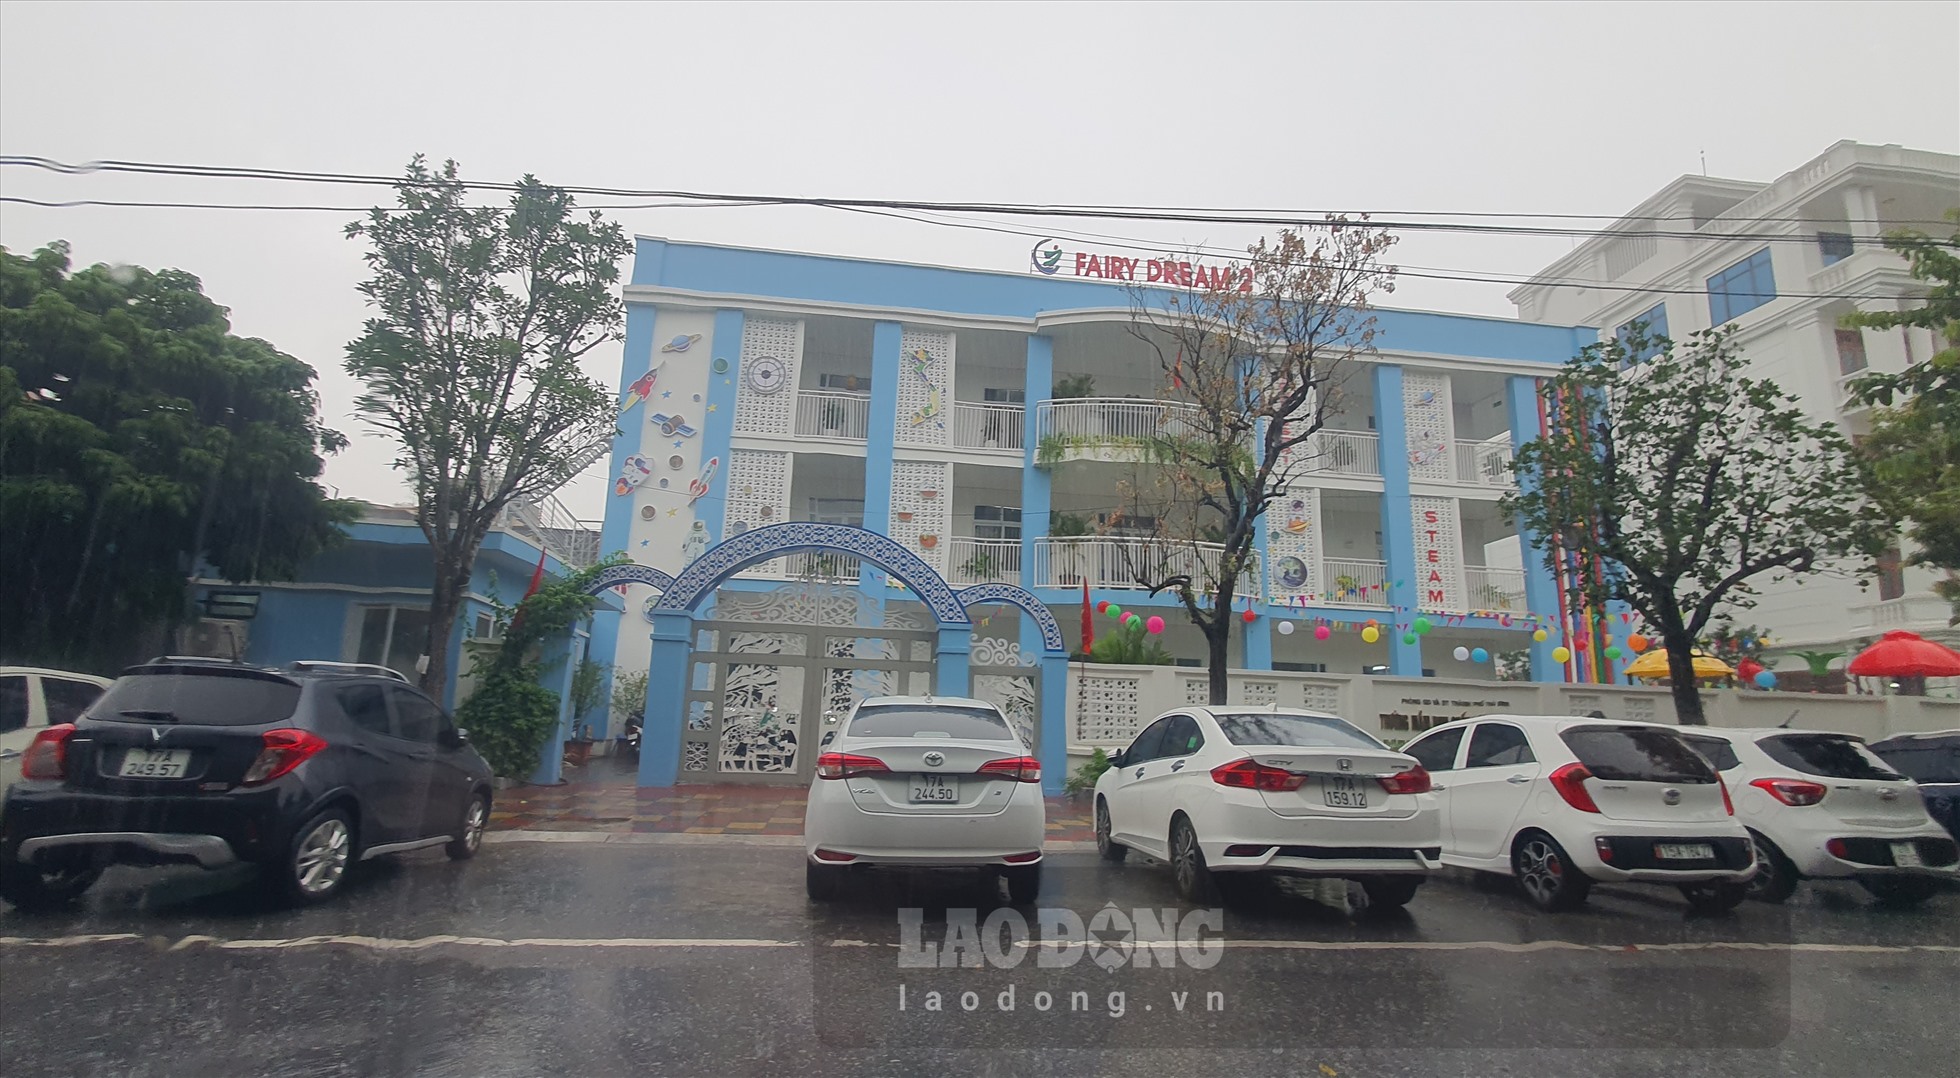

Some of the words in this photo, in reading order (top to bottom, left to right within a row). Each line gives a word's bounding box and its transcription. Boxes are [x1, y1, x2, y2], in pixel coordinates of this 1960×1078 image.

[1075, 252, 1139, 281] FAIRY
[1147, 259, 1231, 291] DREAM
[1238, 267, 1254, 292] 2
[1424, 510, 1444, 604] STEAM
[146, 749, 174, 762] 17A
[126, 763, 181, 776] 249.57
[924, 776, 944, 787] 17A
[1333, 776, 1355, 791] 17A
[914, 788, 953, 800] 244.50
[1327, 791, 1365, 806] 159.12
